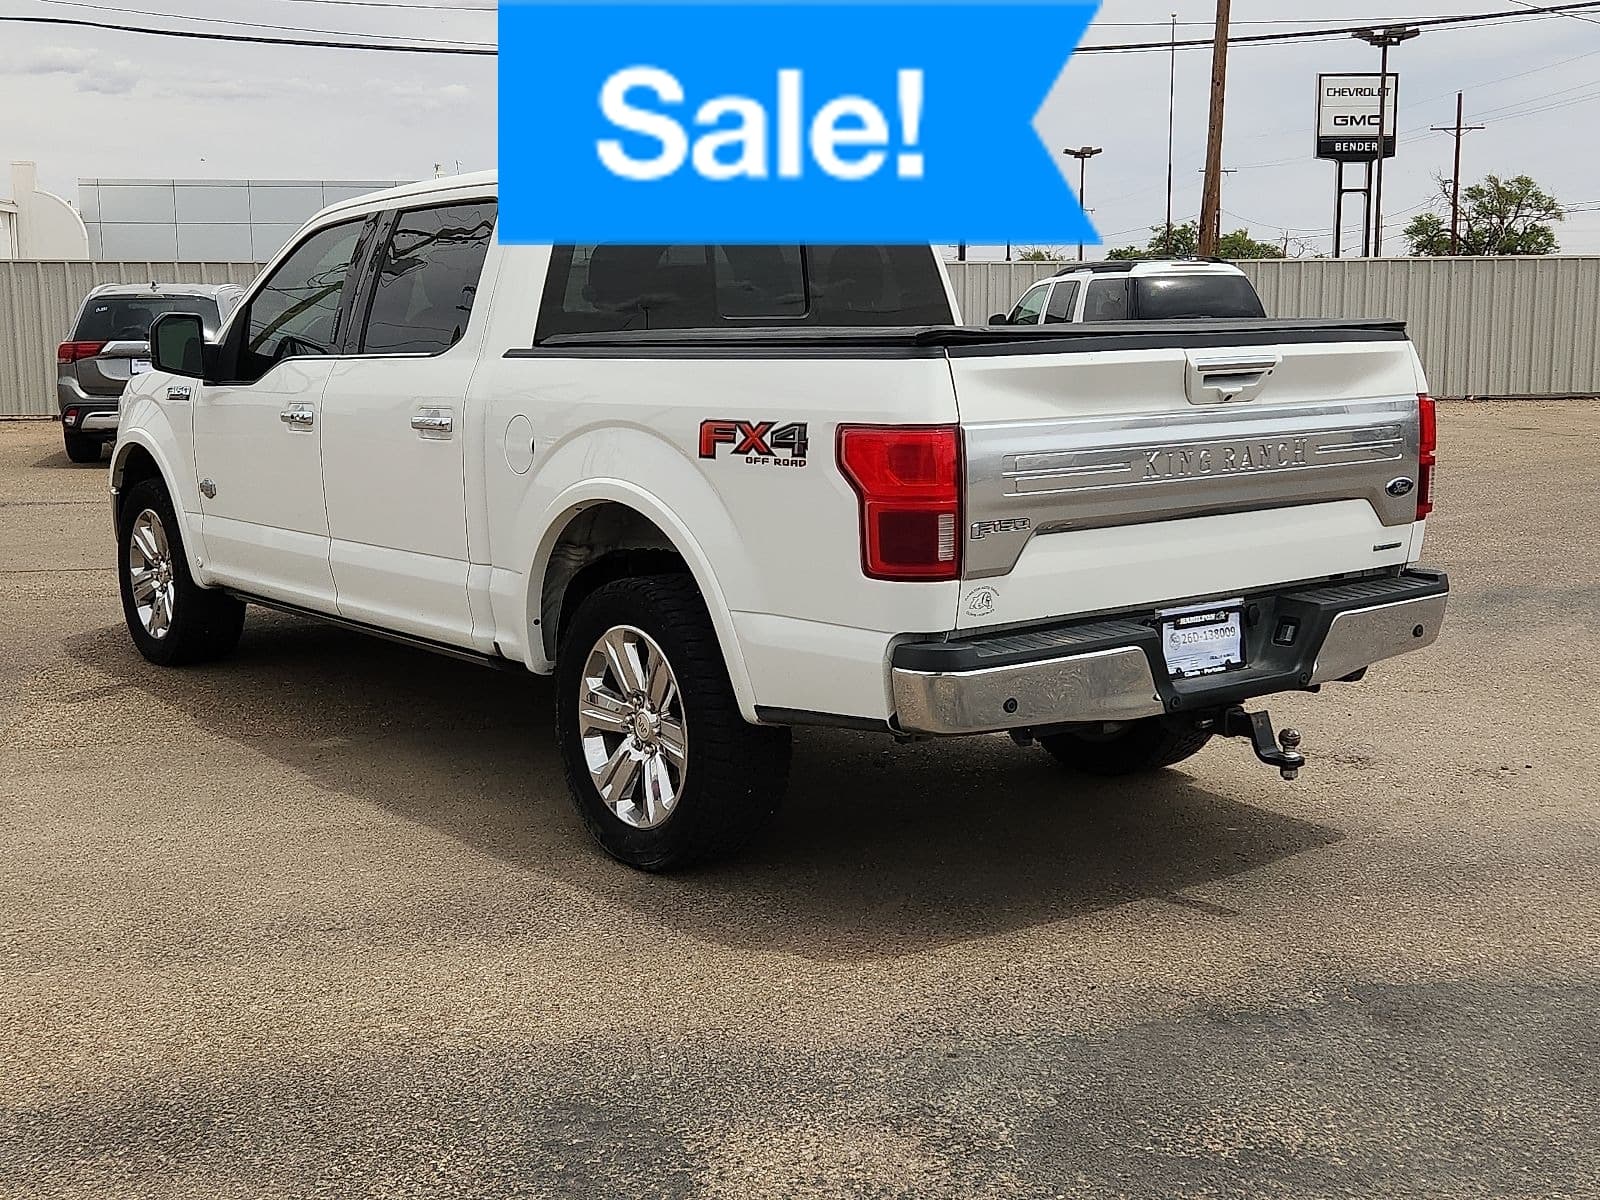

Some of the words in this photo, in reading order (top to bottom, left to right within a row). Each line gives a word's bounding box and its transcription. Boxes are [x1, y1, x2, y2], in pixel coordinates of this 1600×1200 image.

[1333, 114, 1382, 126] GMC
[1335, 142, 1378, 152] BENDER
[698, 419, 808, 460] FX4
[745, 456, 769, 465] OFF
[774, 458, 807, 467] ROAD
[1142, 449, 1212, 479] KING
[1221, 437, 1308, 472] RANCH
